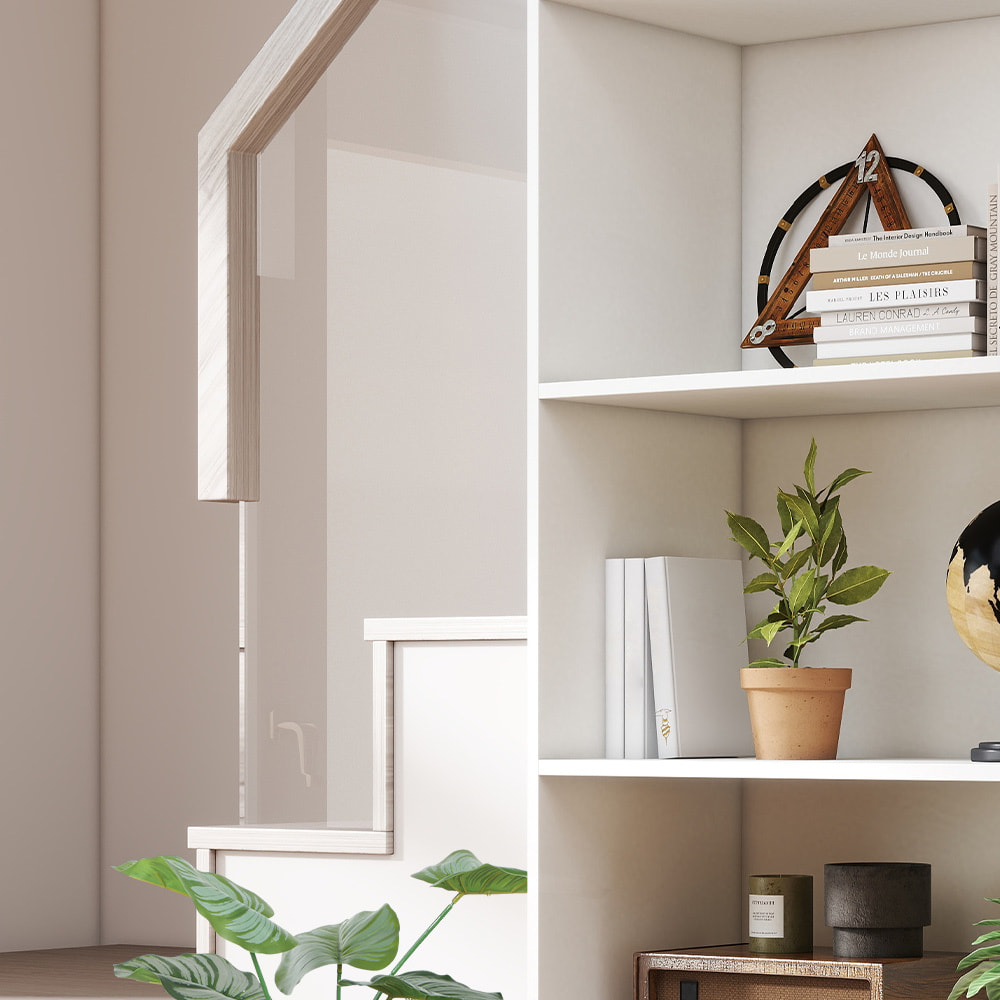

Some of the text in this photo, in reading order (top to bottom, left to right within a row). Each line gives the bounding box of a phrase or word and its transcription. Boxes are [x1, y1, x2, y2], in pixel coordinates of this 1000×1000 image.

[855, 150, 880, 183] 12
[989, 194, 998, 251] MOUNTAIN
[872, 234, 882, 242] The
[883, 233, 903, 241] Interior
[904, 231, 923, 240] Design
[924, 228, 953, 238] Handbook
[858, 246, 929, 262] Le Monde Journal
[989, 253, 998, 281] GRAY
[870, 287, 949, 302] LES PLAISIRS
[989, 286, 998, 299] DE
[836, 308, 920, 323] LAUREN CONRAD
[989, 301, 998, 345] SECRETO
[749, 319, 777, 345] 8
[849, 322, 940, 337] BRAND MANAGEMENT
